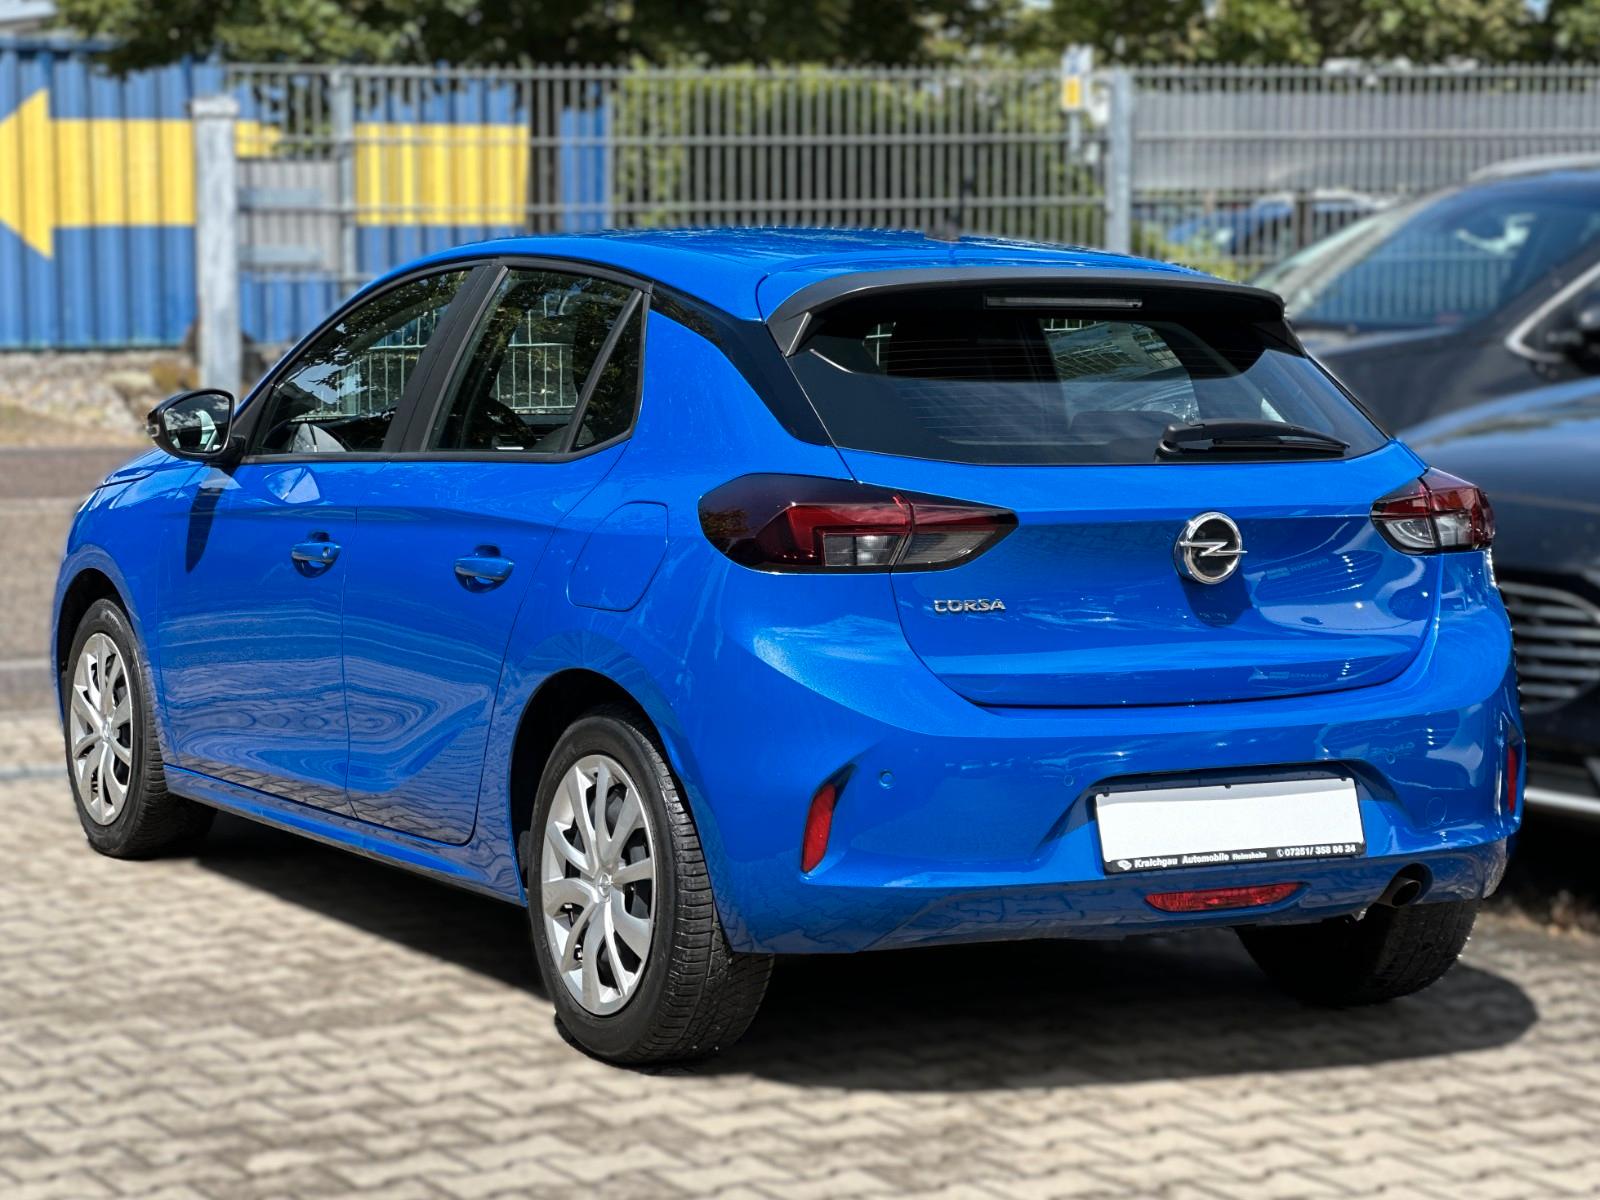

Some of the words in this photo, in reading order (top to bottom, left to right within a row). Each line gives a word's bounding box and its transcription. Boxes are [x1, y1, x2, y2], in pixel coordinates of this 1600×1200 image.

[934, 599, 1006, 612] CORSA
[1182, 853, 1229, 865] Automobile
[1344, 843, 1356, 853] 24
